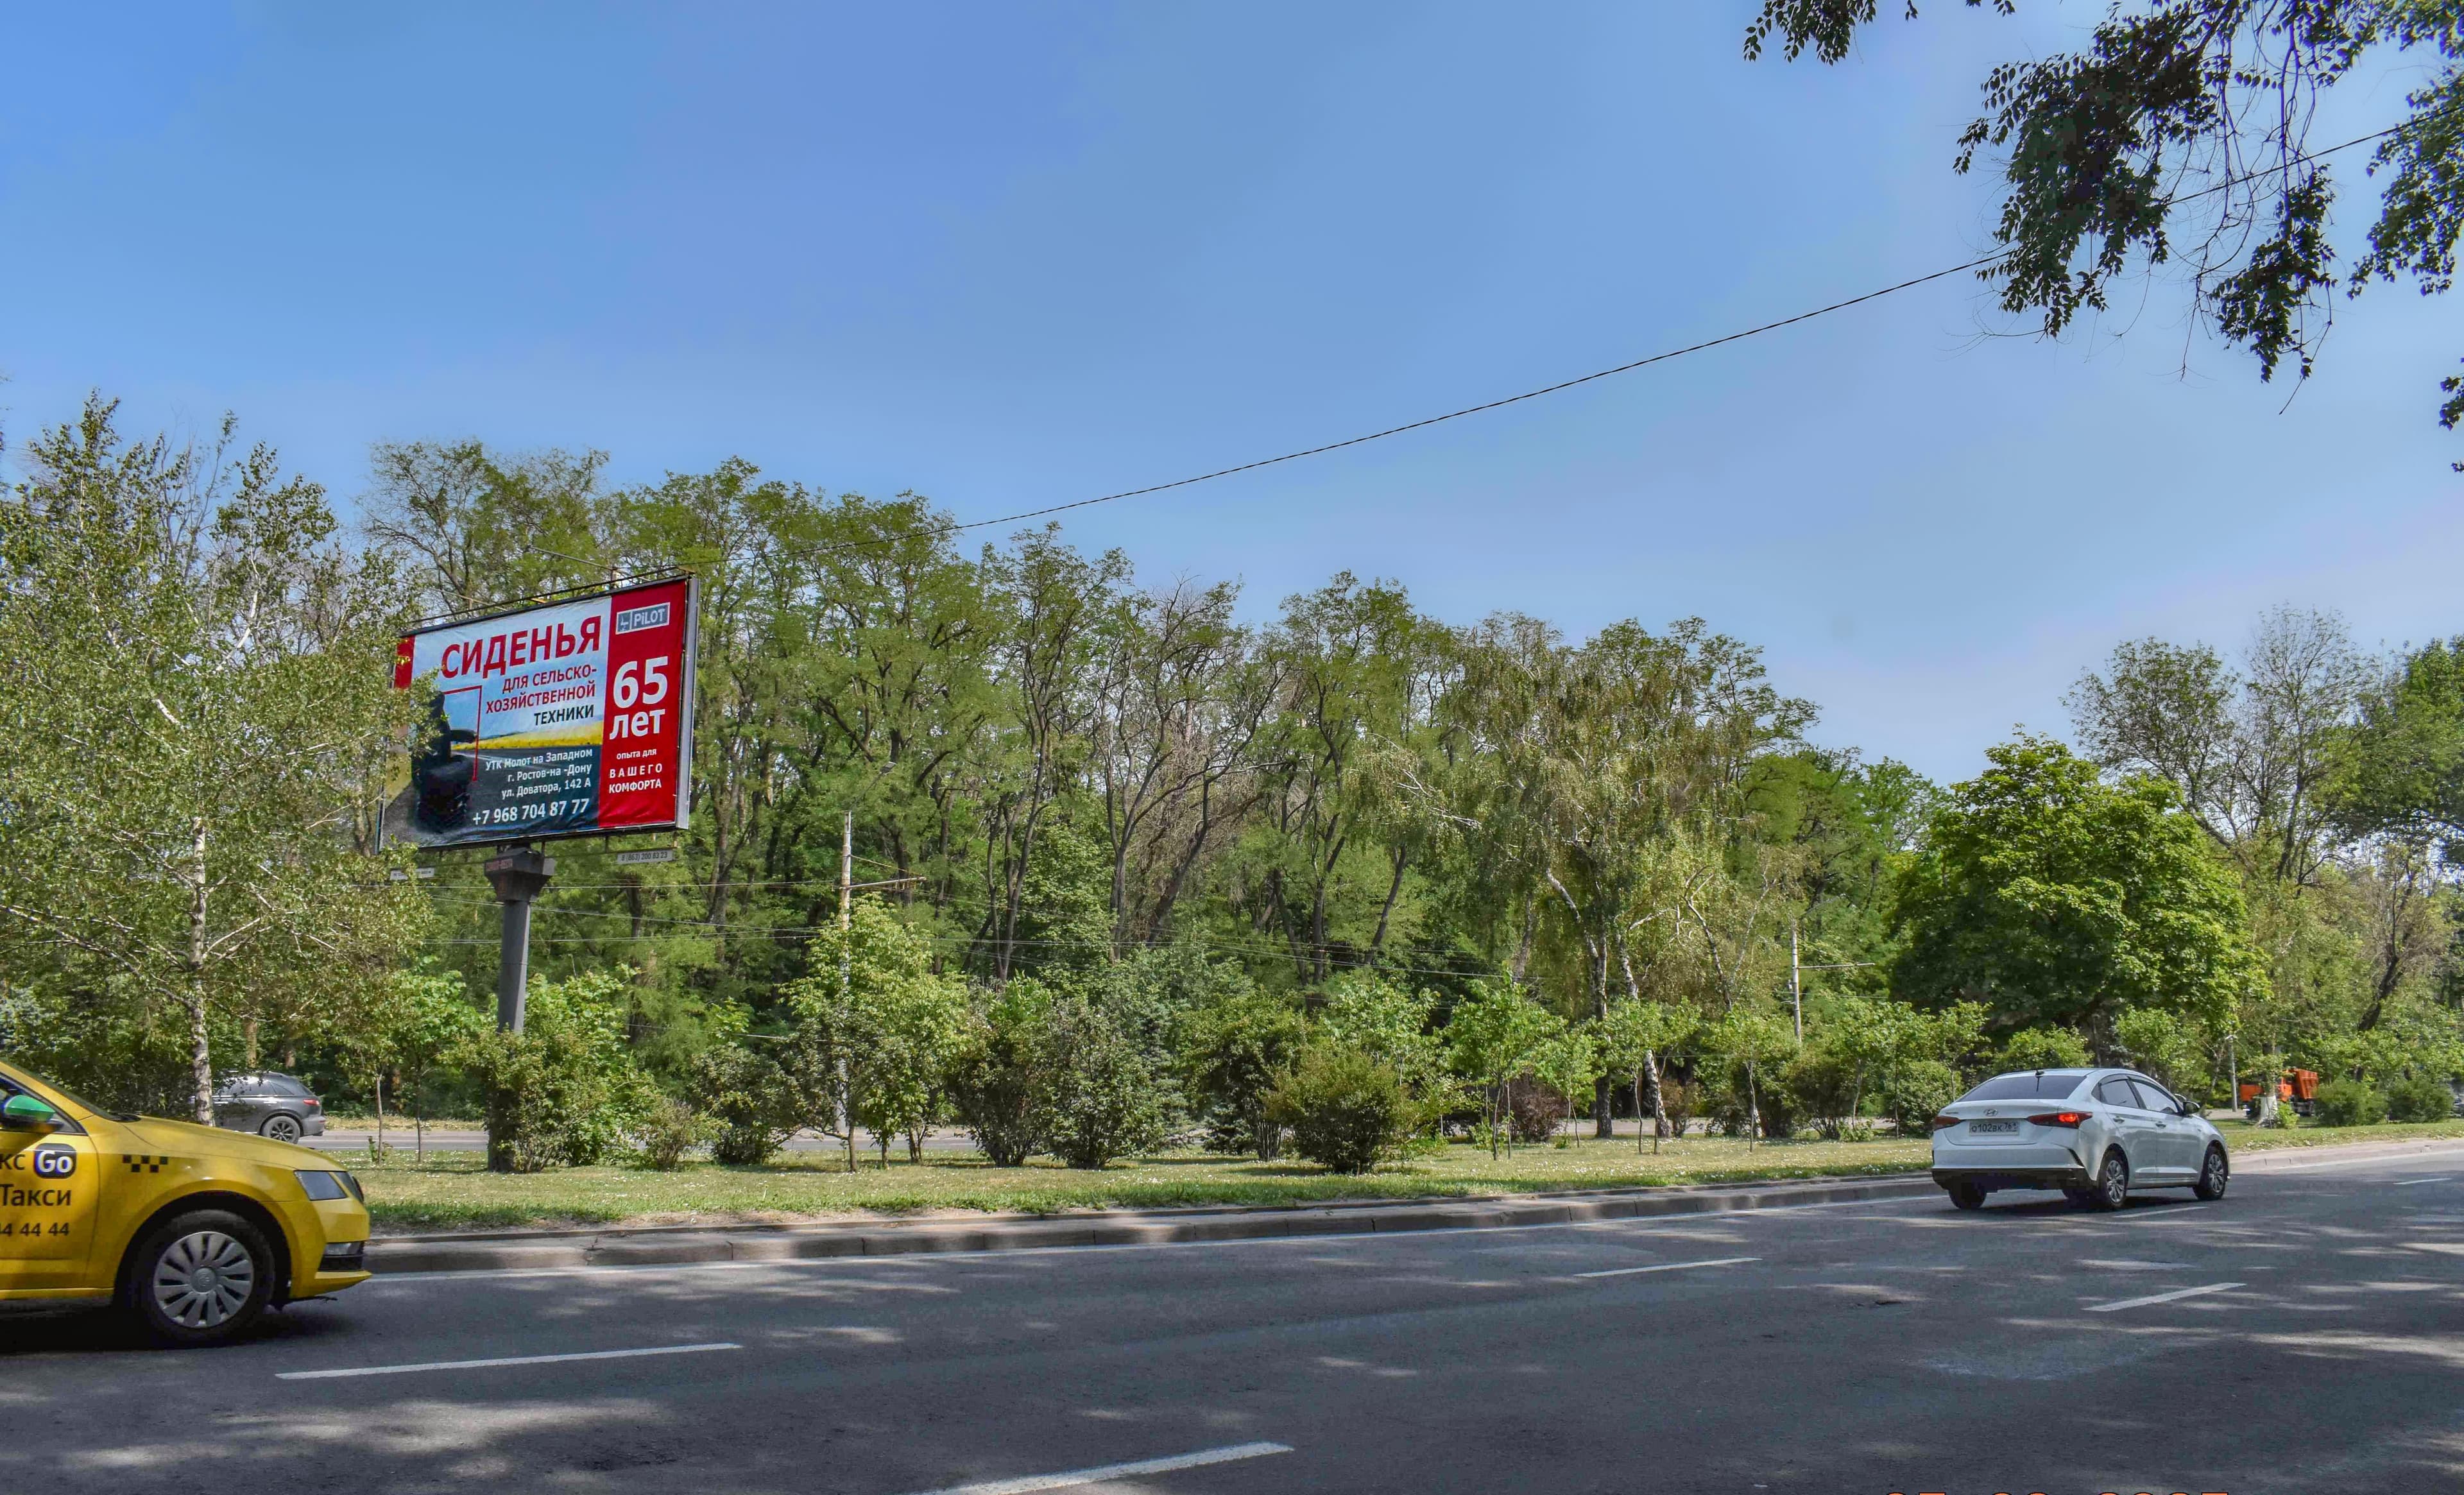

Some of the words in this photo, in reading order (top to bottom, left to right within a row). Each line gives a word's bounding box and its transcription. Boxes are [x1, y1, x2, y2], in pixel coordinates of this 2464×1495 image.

[441, 615, 601, 679] СИДЕНЬЯ
[502, 675, 529, 694] ДЛЯ
[533, 664, 597, 686] СЕЛЬСКО-
[613, 656, 668, 708] 65
[486, 680, 595, 713] ХОЗЯЙСТВЕННОЙ
[534, 705, 594, 726] ТЕХНИКИ
[609, 708, 665, 740] лет
[486, 758, 502, 771] УТК
[504, 757, 531, 768] Молот
[533, 755, 543, 764] на
[546, 749, 593, 762] Западном
[617, 750, 640, 760] опыта
[642, 749, 657, 758] для
[517, 768, 561, 781] Ростов-на
[564, 764, 592, 776] -Дону
[610, 763, 662, 778] ВАШЕГО
[502, 789, 515, 799] ул.
[517, 782, 561, 797] Доватора,
[565, 778, 581, 790] 142
[584, 778, 591, 788] А
[609, 778, 662, 794] КОМФОРТА
[472, 809, 490, 825] +7
[493, 807, 518, 823] 968
[522, 803, 545, 820] 704
[550, 800, 567, 817] 87
[571, 798, 590, 814] 77
[641, 851, 651, 860] 200
[1971, 1123, 2003, 1132] О102ВК
[38, 1150, 73, 1173] Go
[0, 1184, 72, 1206] Такси
[0, 1222, 13, 1237] 4
[20, 1222, 41, 1237] 44
[48, 1222, 69, 1236] 44
